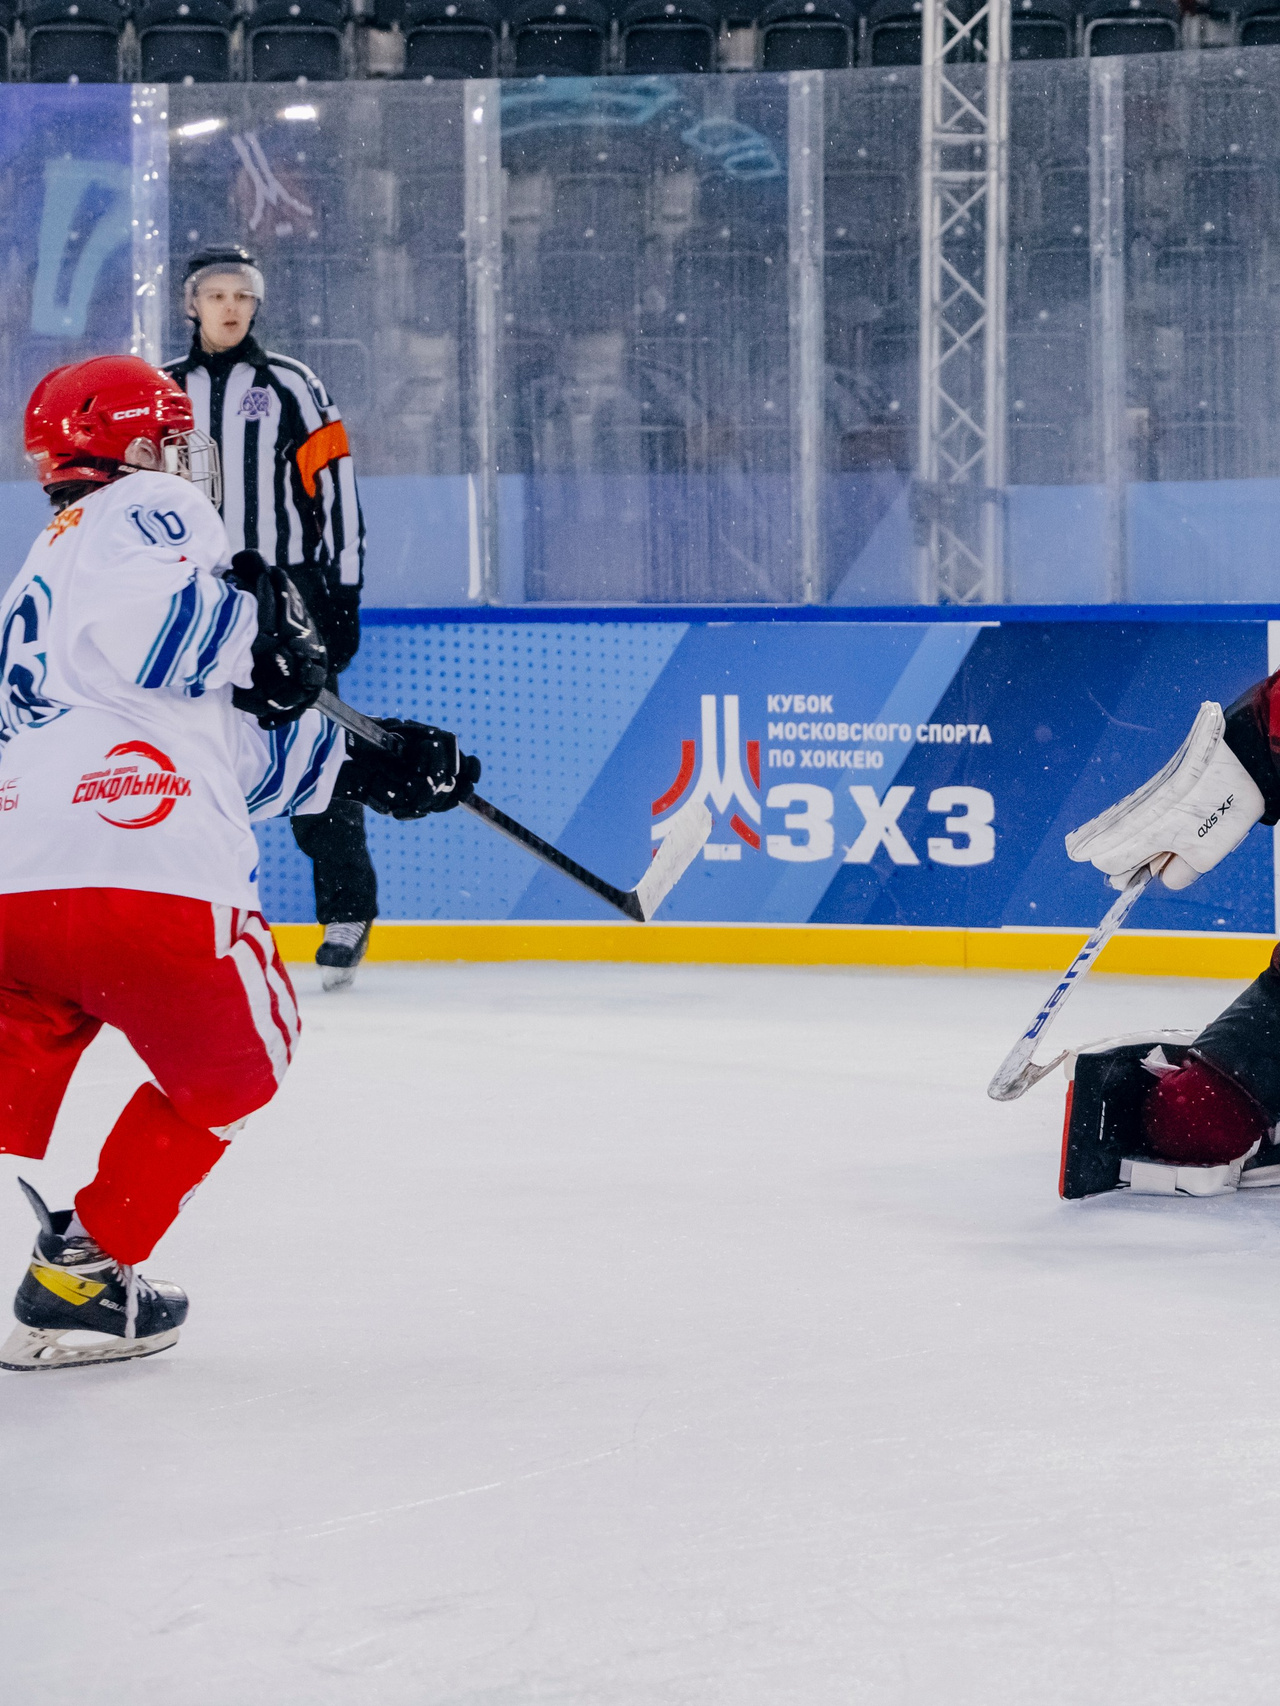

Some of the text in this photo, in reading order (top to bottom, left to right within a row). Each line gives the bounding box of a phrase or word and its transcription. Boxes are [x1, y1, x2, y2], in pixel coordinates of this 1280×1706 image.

[113, 406, 150, 420] CCM
[767, 694, 833, 714] КУБОК
[767, 722, 992, 744] МОСКОВСКОГО СПОРТА
[768, 748, 884, 769] ПО ХОККЕЮ
[99, 1298, 127, 1312] BAU
